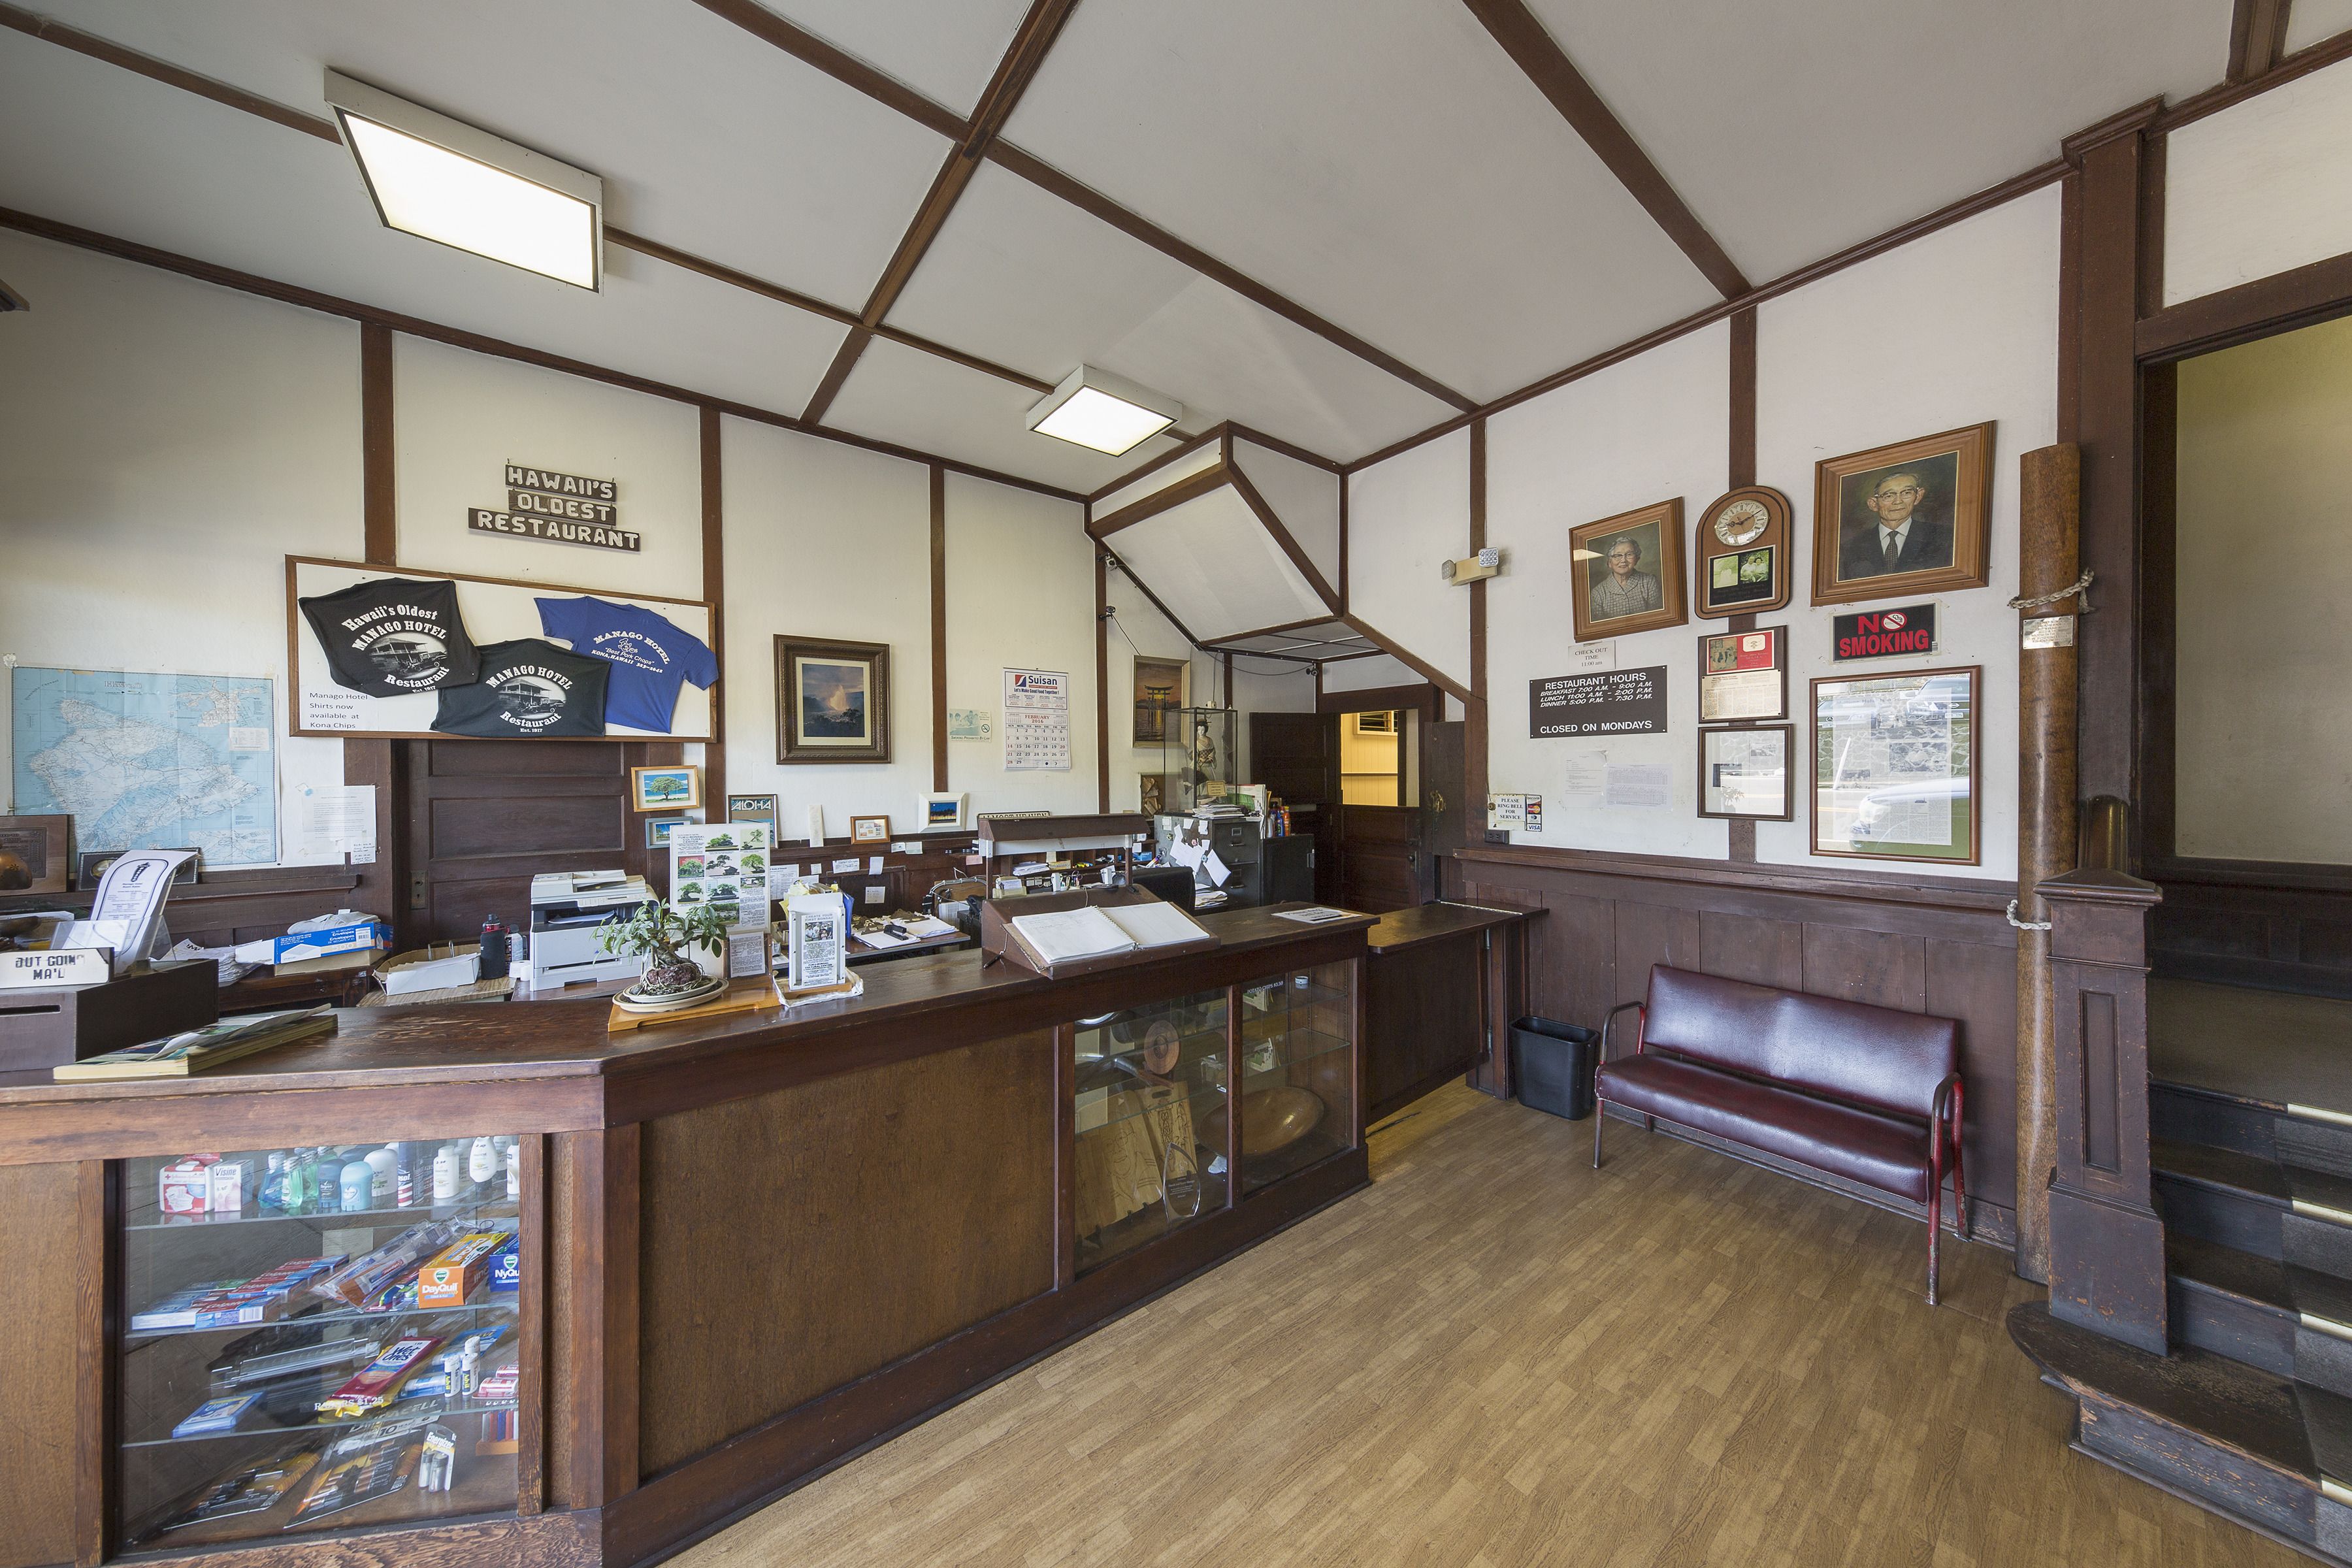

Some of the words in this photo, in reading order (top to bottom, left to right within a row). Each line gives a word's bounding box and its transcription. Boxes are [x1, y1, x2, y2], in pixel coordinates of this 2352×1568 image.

[508, 466, 612, 498] HAWAII'S
[517, 493, 610, 521] OLDEST
[478, 511, 638, 549] RESTAURANT
[341, 605, 396, 631] Hawaii's
[397, 604, 438, 620] Oldest
[351, 621, 402, 651] MANAGO
[404, 621, 447, 640] HOTEL
[1839, 629, 1929, 657] SMOKING
[593, 630, 643, 644] MANAGO
[644, 637, 670, 664] HOTEL
[636, 662, 663, 674] 323-2642
[384, 666, 449, 688] Restaurant
[485, 665, 535, 688] MANAGO
[538, 666, 573, 690] HOTEL
[1028, 675, 1057, 685] Suisan
[1545, 677, 1605, 690] RESTAURANT
[1610, 672, 1646, 683] HOURS
[1541, 688, 1576, 696] BREAKFAST
[500, 711, 562, 727] Restaurant
[1541, 725, 1578, 734] CLOSED
[1582, 723, 1597, 732] ON
[1601, 720, 1652, 731] MONDAYS
[731, 800, 772, 810] ALOHA
[216, 1168, 237, 1176] Visine
[495, 1269, 519, 1279] NyQu
[421, 1282, 459, 1294] DayQuil
[382, 1352, 410, 1361] Ones
[393, 1346, 421, 1356] Wet
[357, 1396, 384, 1405] $1.25
[427, 1431, 454, 1448] Energizer
